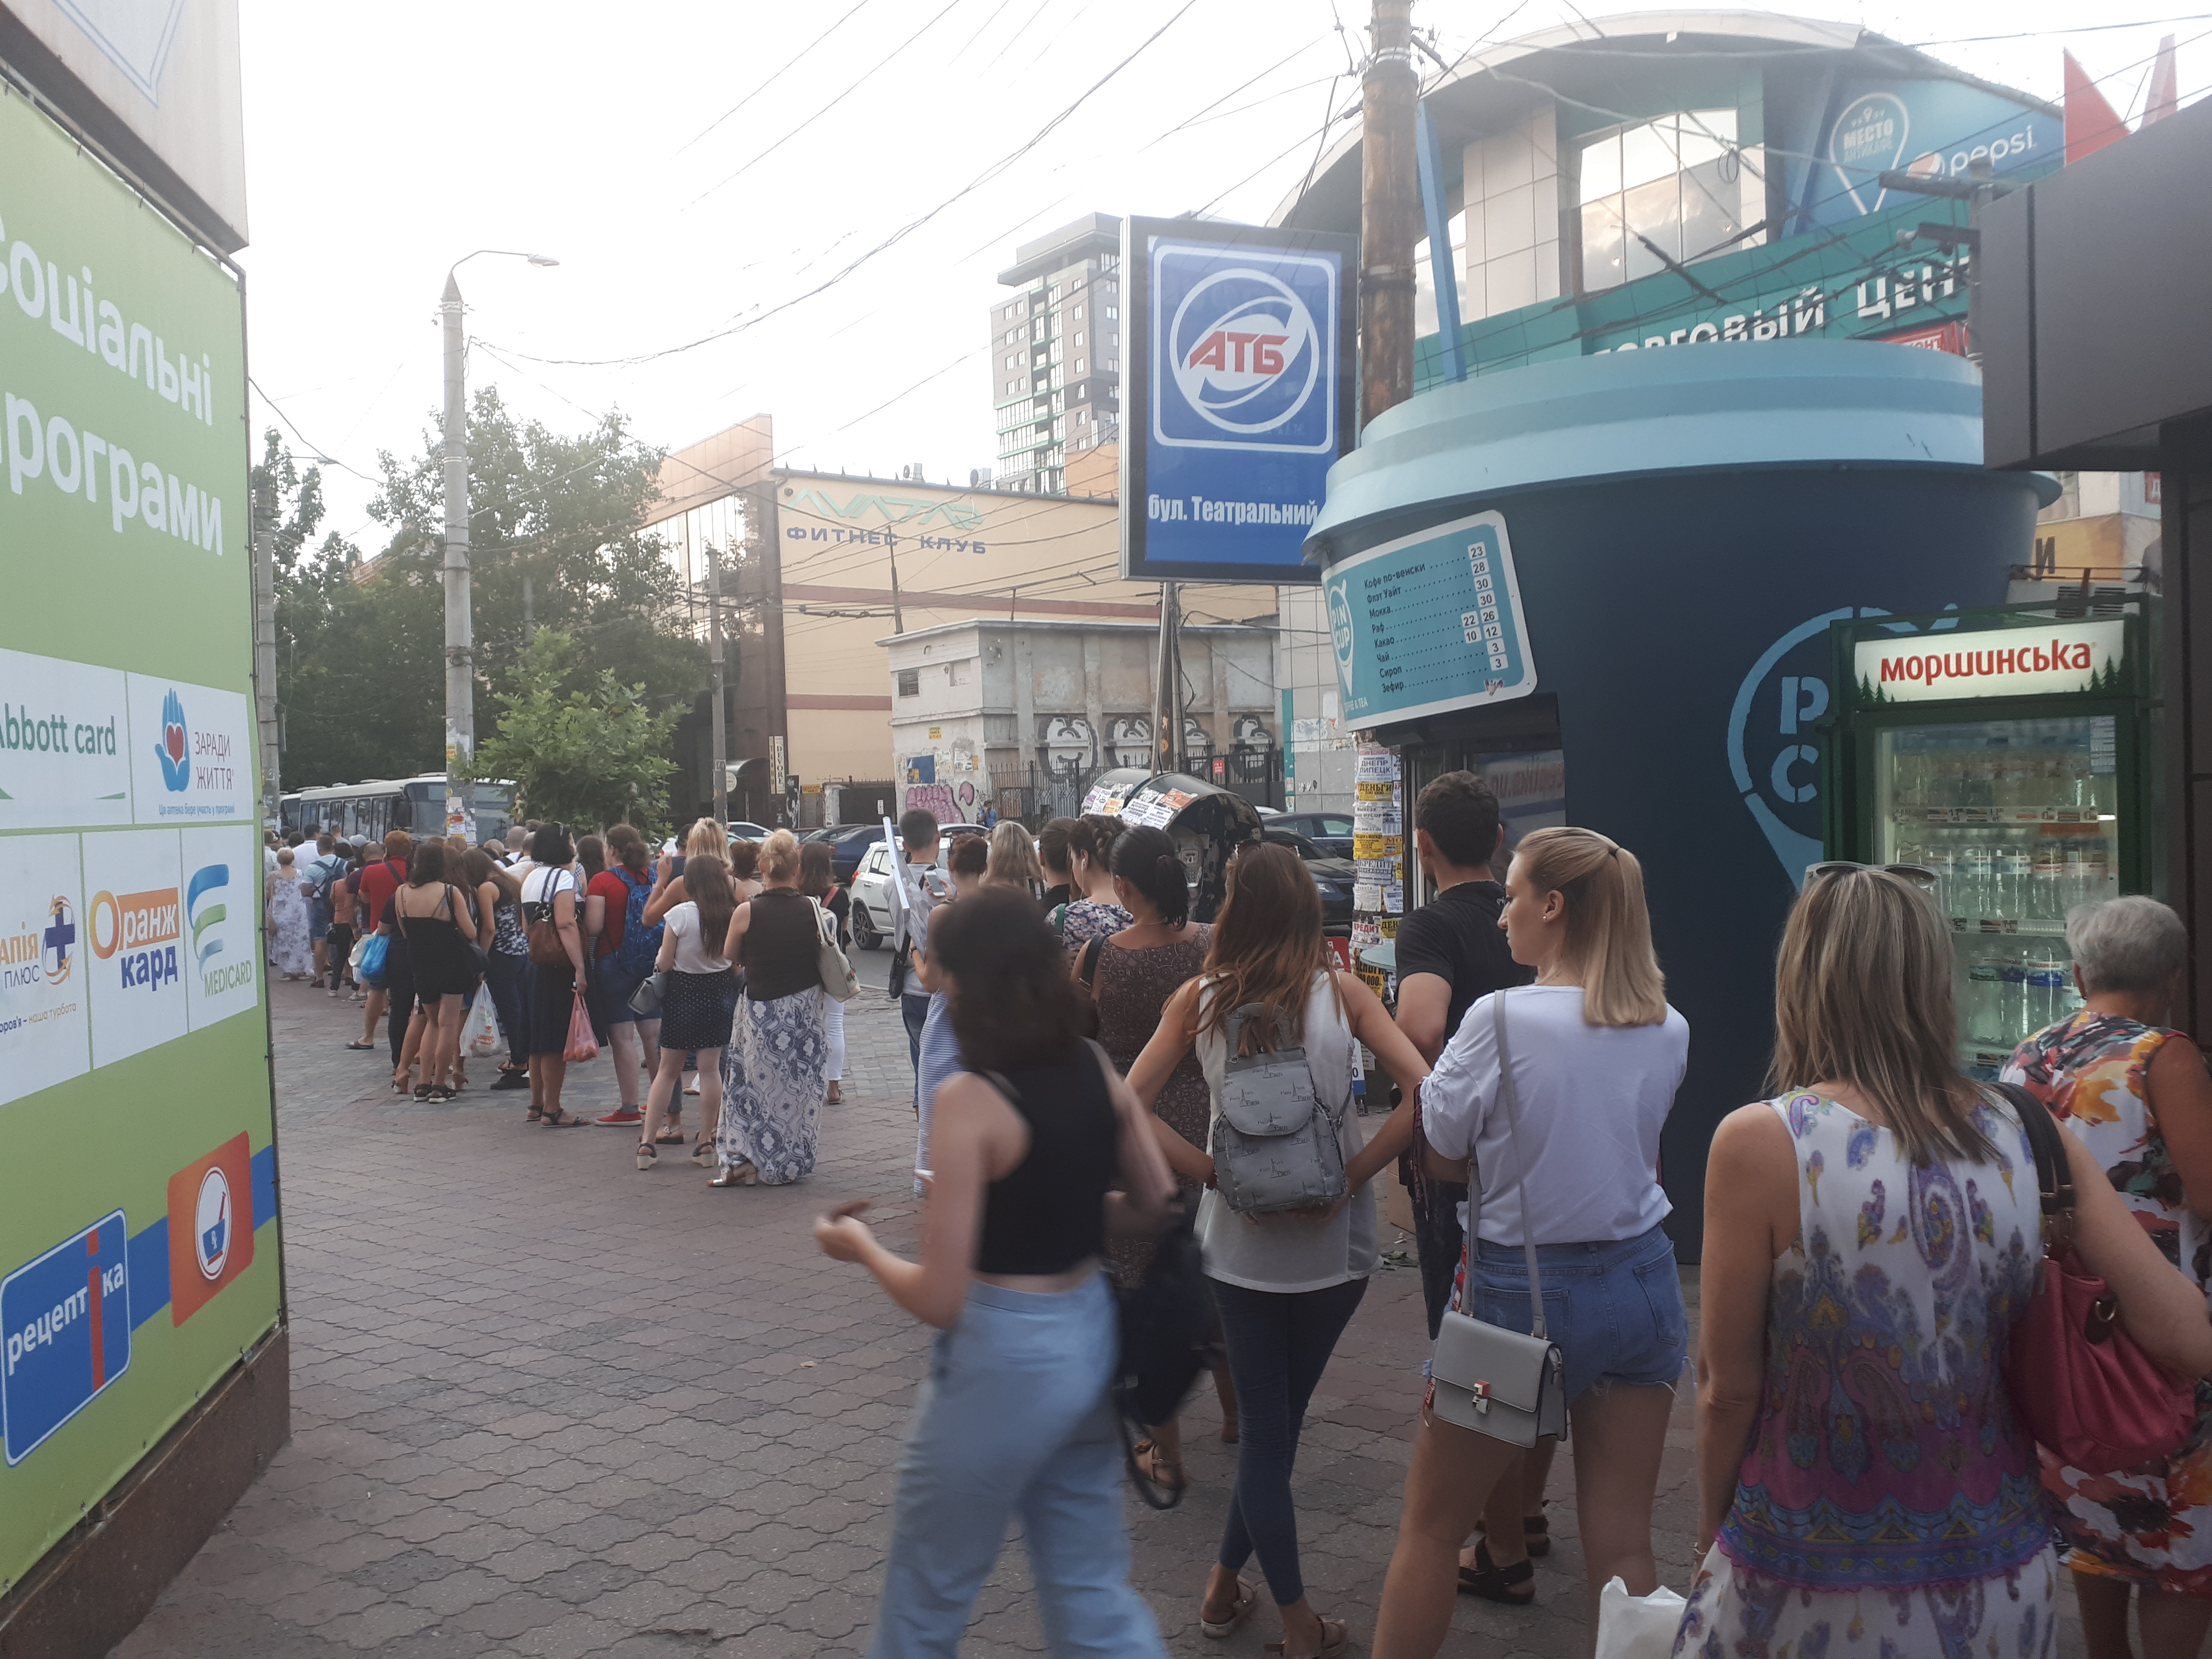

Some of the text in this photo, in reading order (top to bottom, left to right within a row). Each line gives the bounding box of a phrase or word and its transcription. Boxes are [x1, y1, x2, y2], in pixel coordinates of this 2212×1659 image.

[1951, 124, 2032, 177] pepsi
[1190, 331, 1290, 375] АТБ
[0, 391, 223, 556] рограми
[1149, 494, 1319, 526] бул. Театральний
[786, 527, 986, 554] ФИТНЕС КЛУБ
[1364, 546, 1483, 589] Кофе по-венски 23
[1367, 562, 1485, 604] Флэт Уайт 28
[1476, 578, 1489, 589] 30
[1332, 603, 1347, 628] PIN
[1372, 594, 1493, 635] Раф 30
[1374, 610, 1495, 649] Какао 22 26
[1335, 627, 1350, 650] CUP
[1377, 626, 1498, 663] Чай 10 12
[1380, 642, 1499, 679] Сироп 3
[1382, 658, 1502, 694] Зефир 3
[1880, 639, 2091, 685] моршинська
[1358, 697, 1368, 708] TEA
[74, 715, 116, 756] card
[195, 732, 231, 762] ЗАРАДИ
[196, 767, 233, 790] ЖИТТЯ
[1359, 783, 1392, 792] ДЕНЬГИ
[159, 804, 166, 817] Ця
[167, 806, 184, 815] аптека
[89, 890, 178, 960] Оранж
[1354, 923, 1380, 933] КРЕДИТ
[1381, 921, 1399, 929] ДЕН
[5, 965, 40, 989] ПЛЮС
[120, 945, 178, 992] кард
[204, 961, 252, 998] MEDICARD
[29, 1011, 48, 1024] наша
[49, 1002, 77, 1020] турбота
